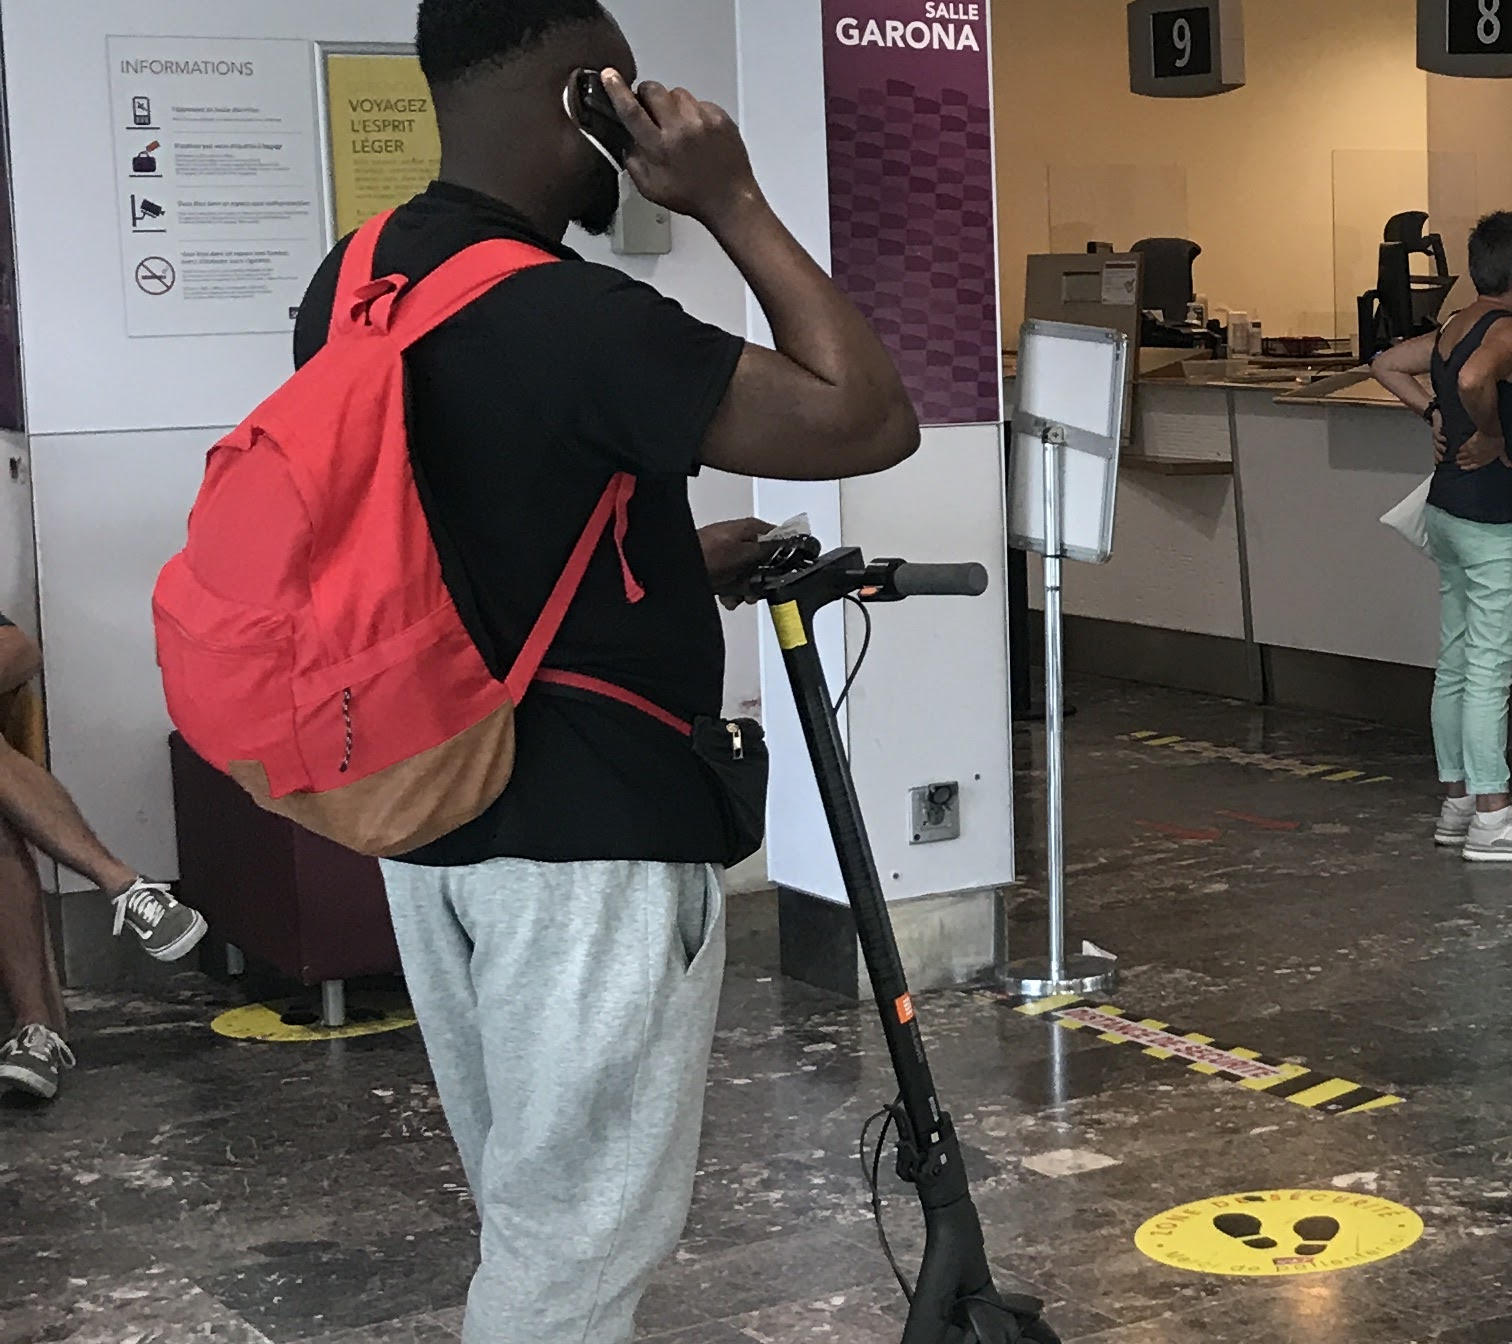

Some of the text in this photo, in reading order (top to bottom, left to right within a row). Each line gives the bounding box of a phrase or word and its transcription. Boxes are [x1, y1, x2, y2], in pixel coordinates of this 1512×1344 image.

[924, 0, 979, 22] SALLE
[835, 16, 980, 52] GARONA
[1172, 17, 1191, 68] 9
[120, 59, 254, 77] INFORMATIONS
[348, 98, 427, 113] VOYAGEZ
[350, 118, 416, 133] L'ESPRIT
[352, 137, 405, 154] LÉGER
